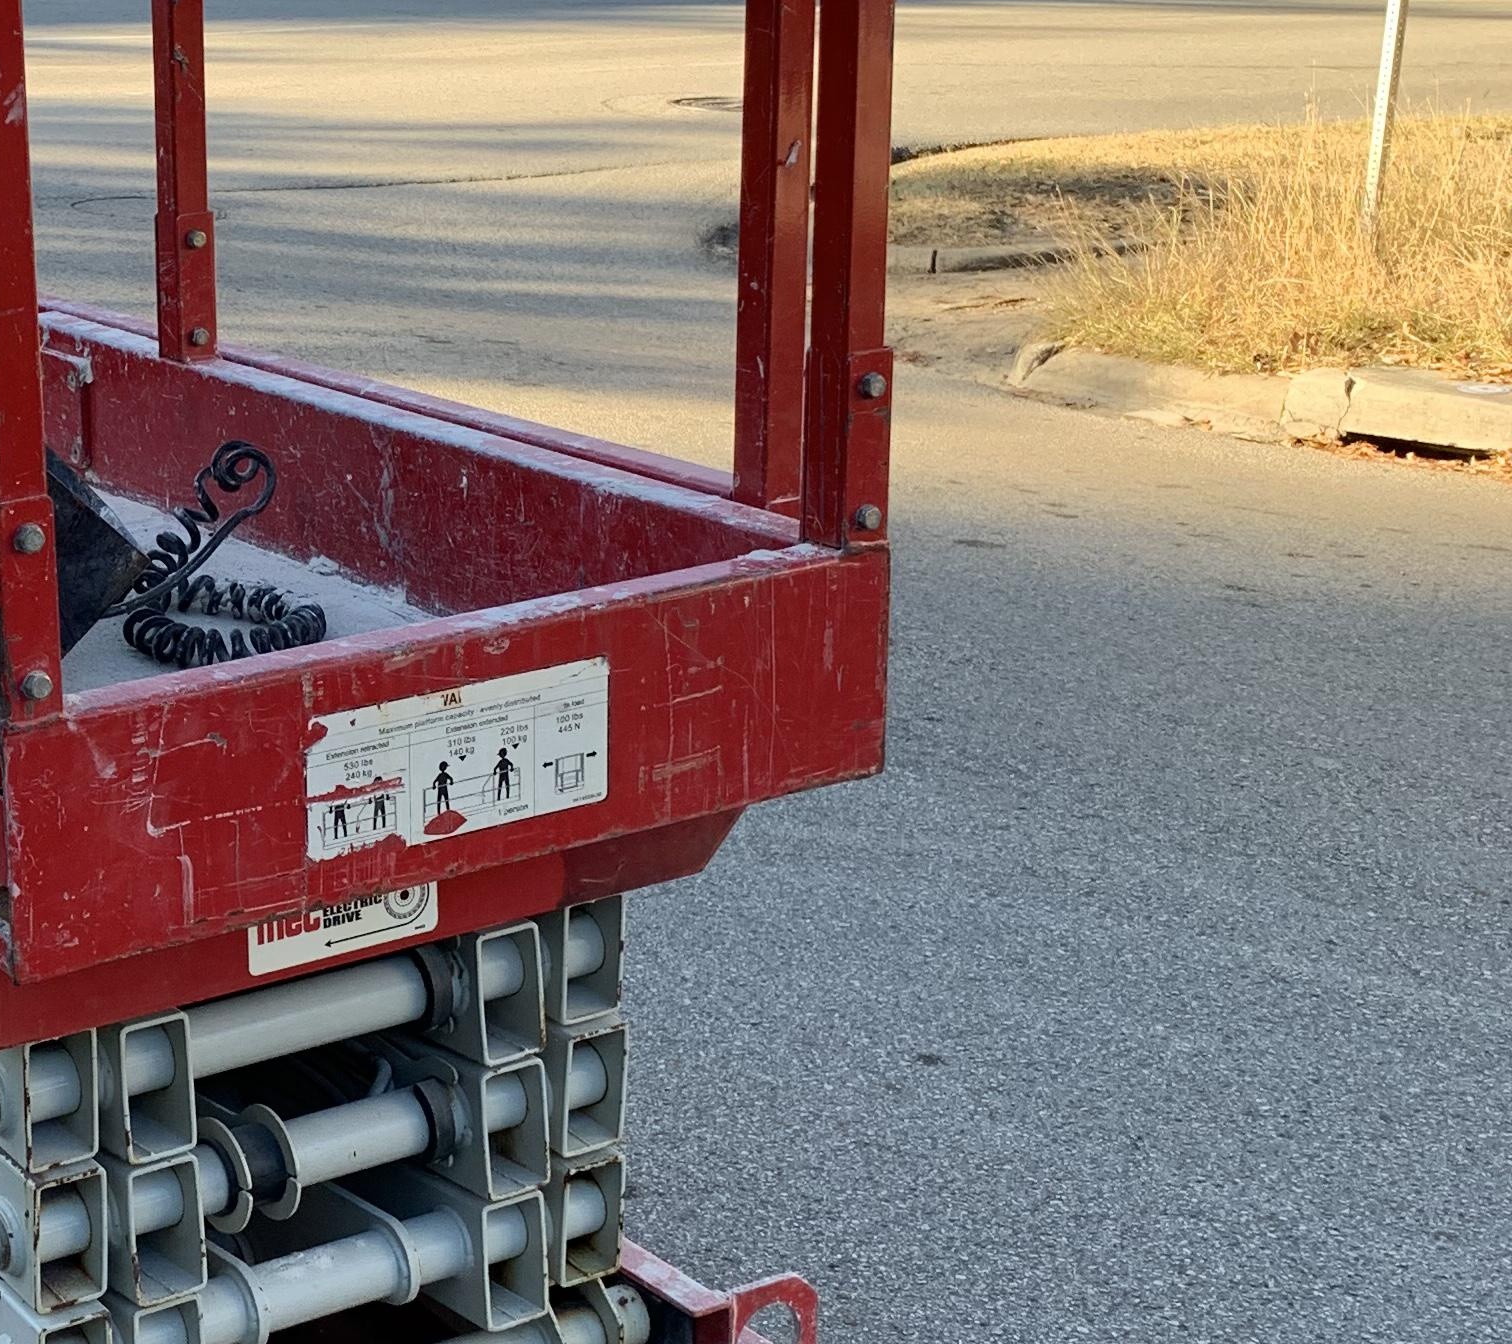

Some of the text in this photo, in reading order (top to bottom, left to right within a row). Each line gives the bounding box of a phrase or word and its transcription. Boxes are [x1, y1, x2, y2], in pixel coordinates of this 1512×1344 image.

[379, 694, 541, 735] Maximum platform capacity evenly distributed
[556, 713, 584, 724] 100 lbs
[445, 715, 508, 734] Extension extended
[500, 724, 529, 736] 220 lbs
[558, 725, 572, 733] 445
[448, 735, 476, 747] 310 lbs
[502, 735, 528, 746] 100 kg
[326, 741, 389, 760] Extension retracted
[449, 746, 475, 757] 140 kg
[344, 760, 359, 771] 530
[346, 770, 373, 781] 240 kg
[503, 804, 529, 816] person
[323, 894, 382, 917] ELECTRIC
[323, 910, 362, 929] DRIVE
